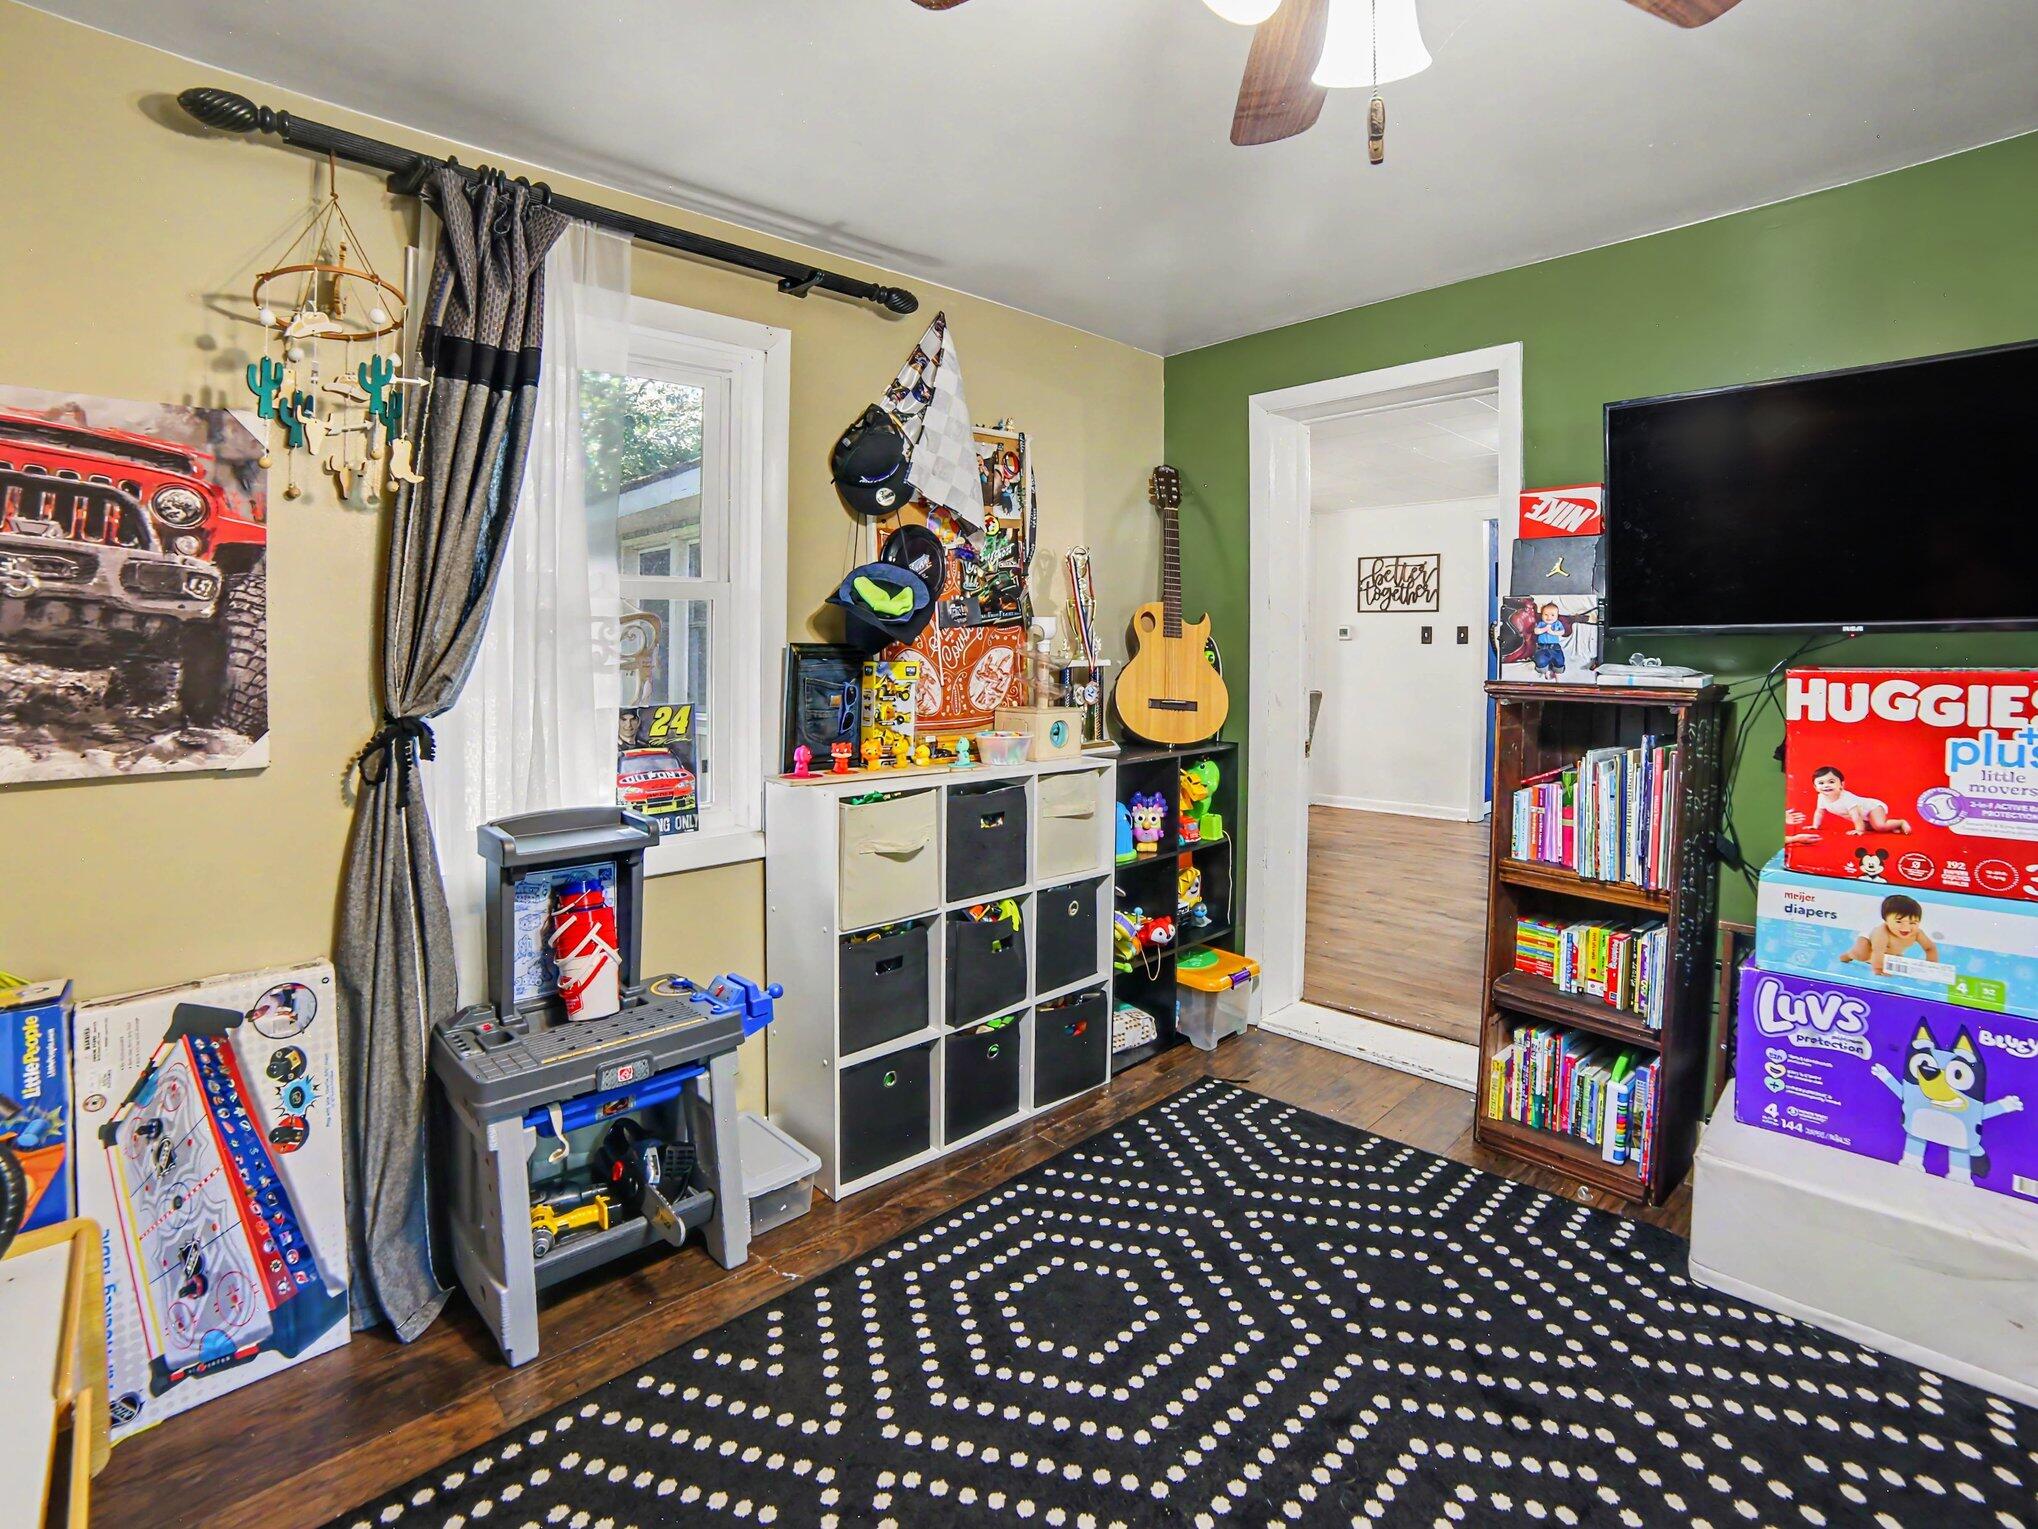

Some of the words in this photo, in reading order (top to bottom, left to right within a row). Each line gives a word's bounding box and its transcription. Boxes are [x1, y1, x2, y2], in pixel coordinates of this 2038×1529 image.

[1524, 496, 1594, 533] NIKE
[1361, 556, 1437, 586] better
[1361, 581, 1437, 611] together
[1786, 678, 2038, 729] HUGGIE
[649, 705, 692, 737] 24
[1981, 769, 2026, 784] little
[1968, 784, 2038, 797] movers
[675, 814, 699, 831] ONLY
[1784, 892, 1816, 903] meijer
[1784, 904, 1838, 920] diapers
[1956, 982, 1969, 994] 4
[1757, 980, 1867, 1034] Luvs
[1796, 1034, 1864, 1054] protection
[1764, 1103, 1779, 1118] 4
[1780, 1118, 1804, 1133] 144
